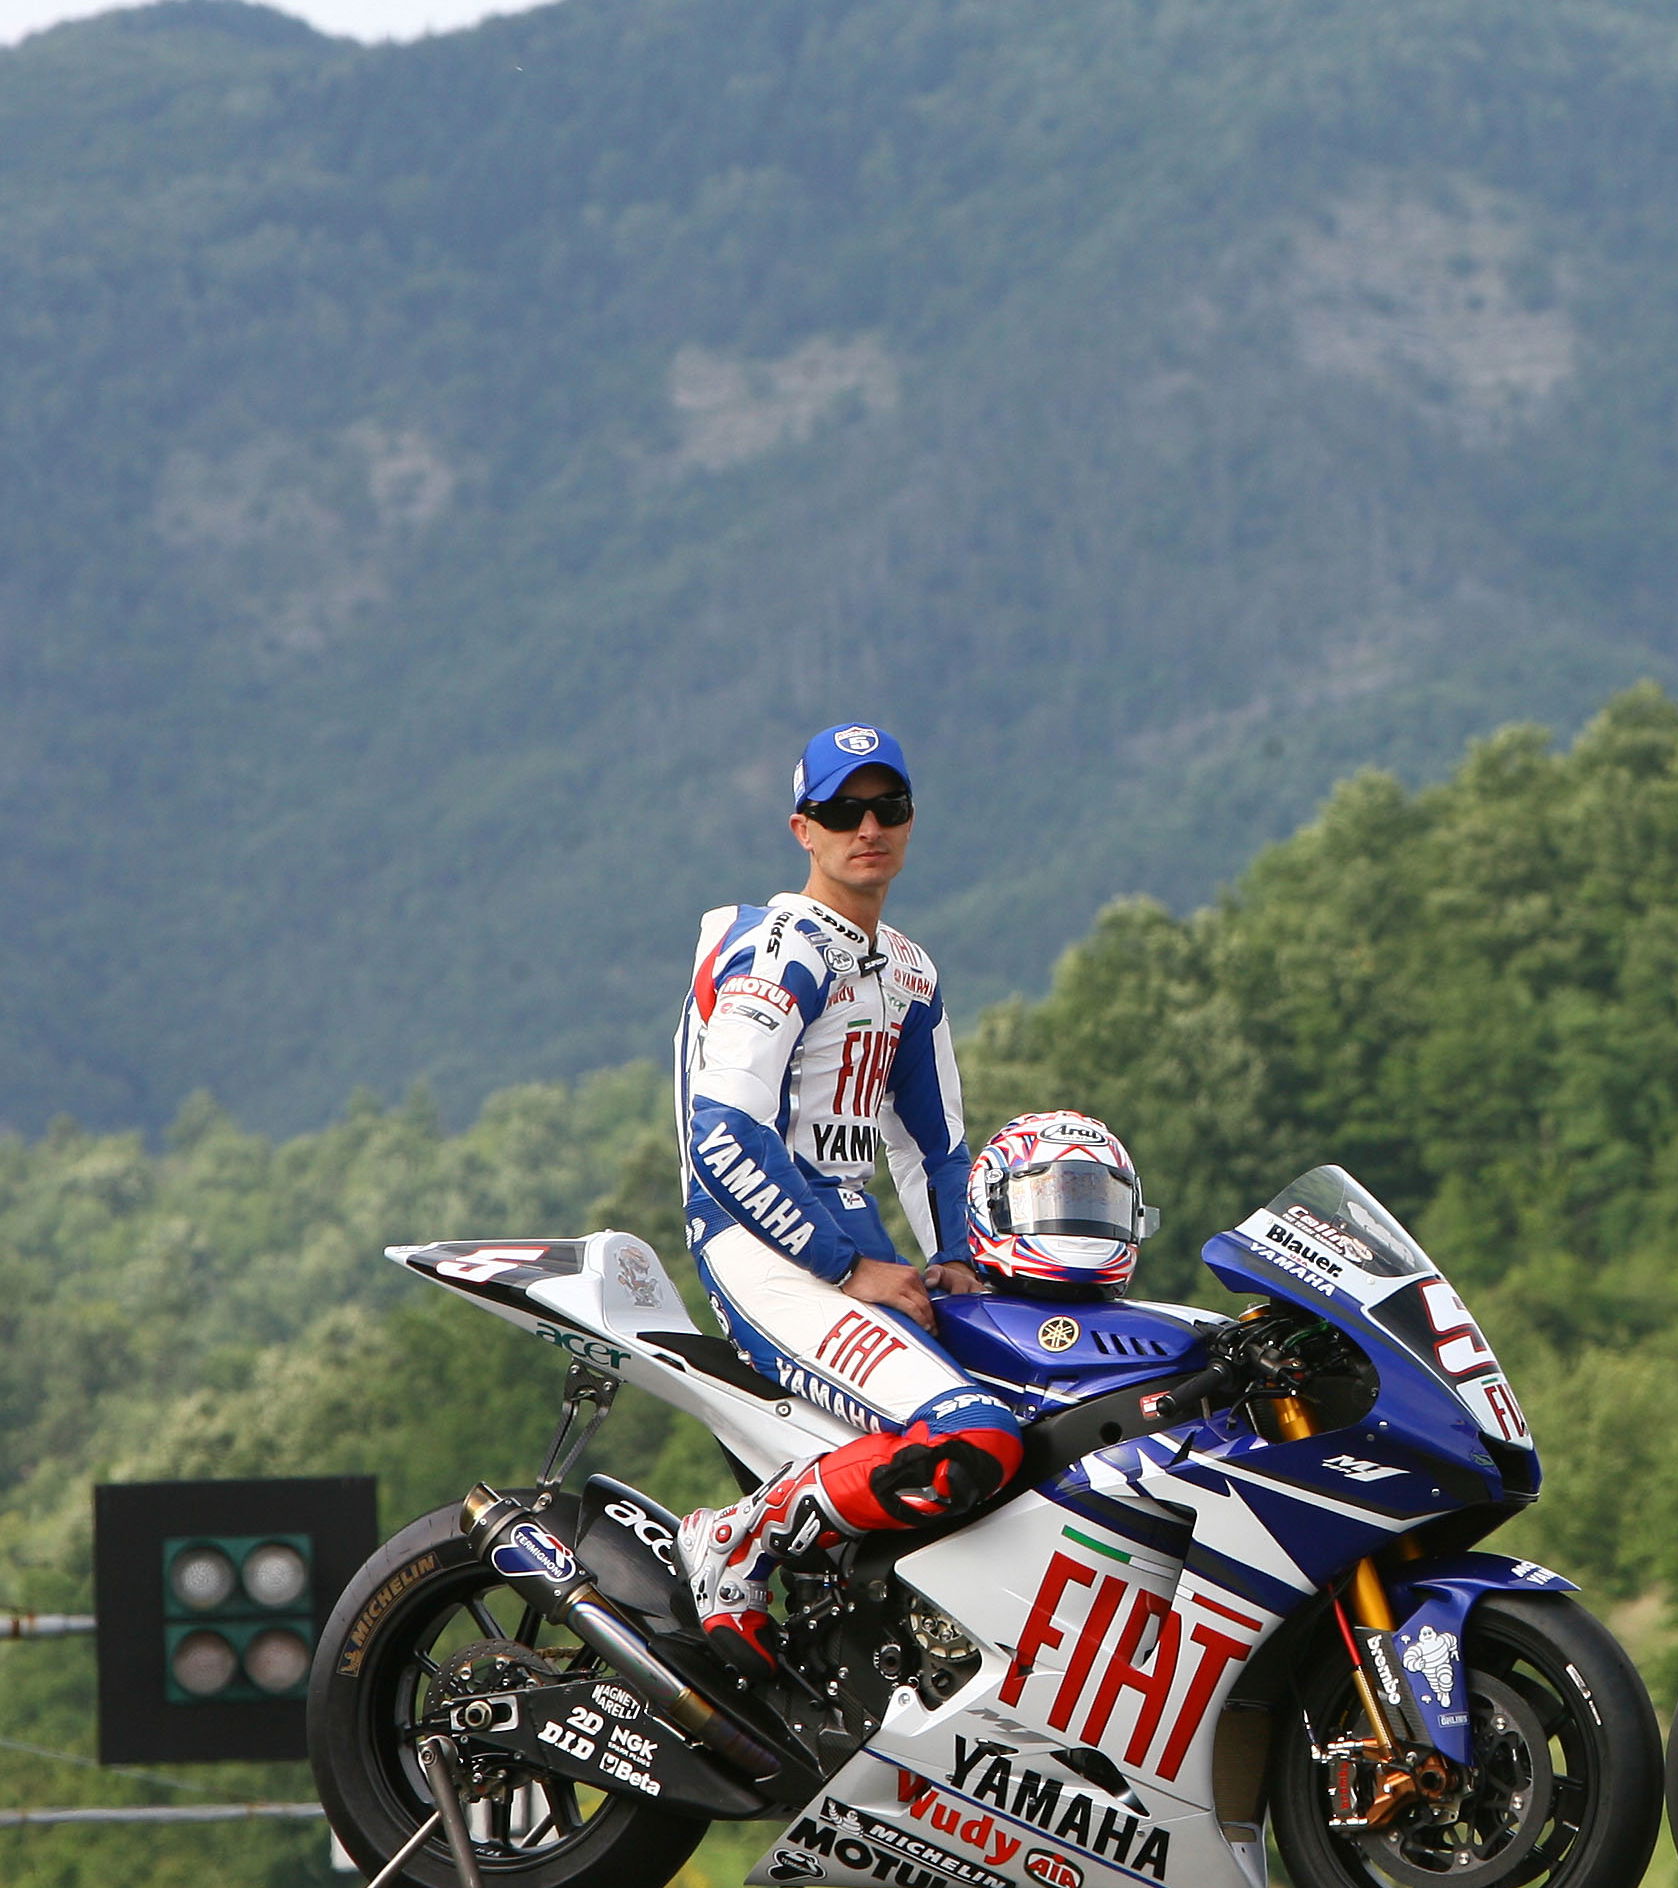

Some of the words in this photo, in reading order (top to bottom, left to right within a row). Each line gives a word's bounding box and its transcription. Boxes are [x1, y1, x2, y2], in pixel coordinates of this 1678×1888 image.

[848, 736, 871, 750] 5
[767, 911, 793, 958] SPIDI
[809, 905, 865, 944] SPIDI
[726, 977, 795, 1013] MOTUL
[1050, 1125, 1098, 1139] Arai
[697, 1121, 815, 1256] YAMAHA
[436, 1246, 549, 1284] 5
[1249, 1242, 1336, 1297] YAMAHA
[536, 1322, 631, 1370] acer
[815, 1310, 908, 1388] FIAT
[776, 1357, 881, 1434] YAMAHA
[515, 1532, 563, 1578] TERMIGNONI
[349, 1555, 436, 1646] MICHELIN
[998, 1550, 1253, 1783] FIAT
[1366, 1634, 1401, 1705] brembo
[566, 1706, 604, 1736] 2D
[592, 1684, 641, 1712] MAGNETI
[592, 1688, 640, 1720] MARELLI
[537, 1720, 596, 1761] D.I.D
[609, 1724, 658, 1760] NGK
[614, 1760, 661, 1797] Beta
[897, 1768, 1022, 1866] Wudy
[950, 1734, 1171, 1881] YAMAHA
[869, 1824, 1007, 1888] MICHELIN
